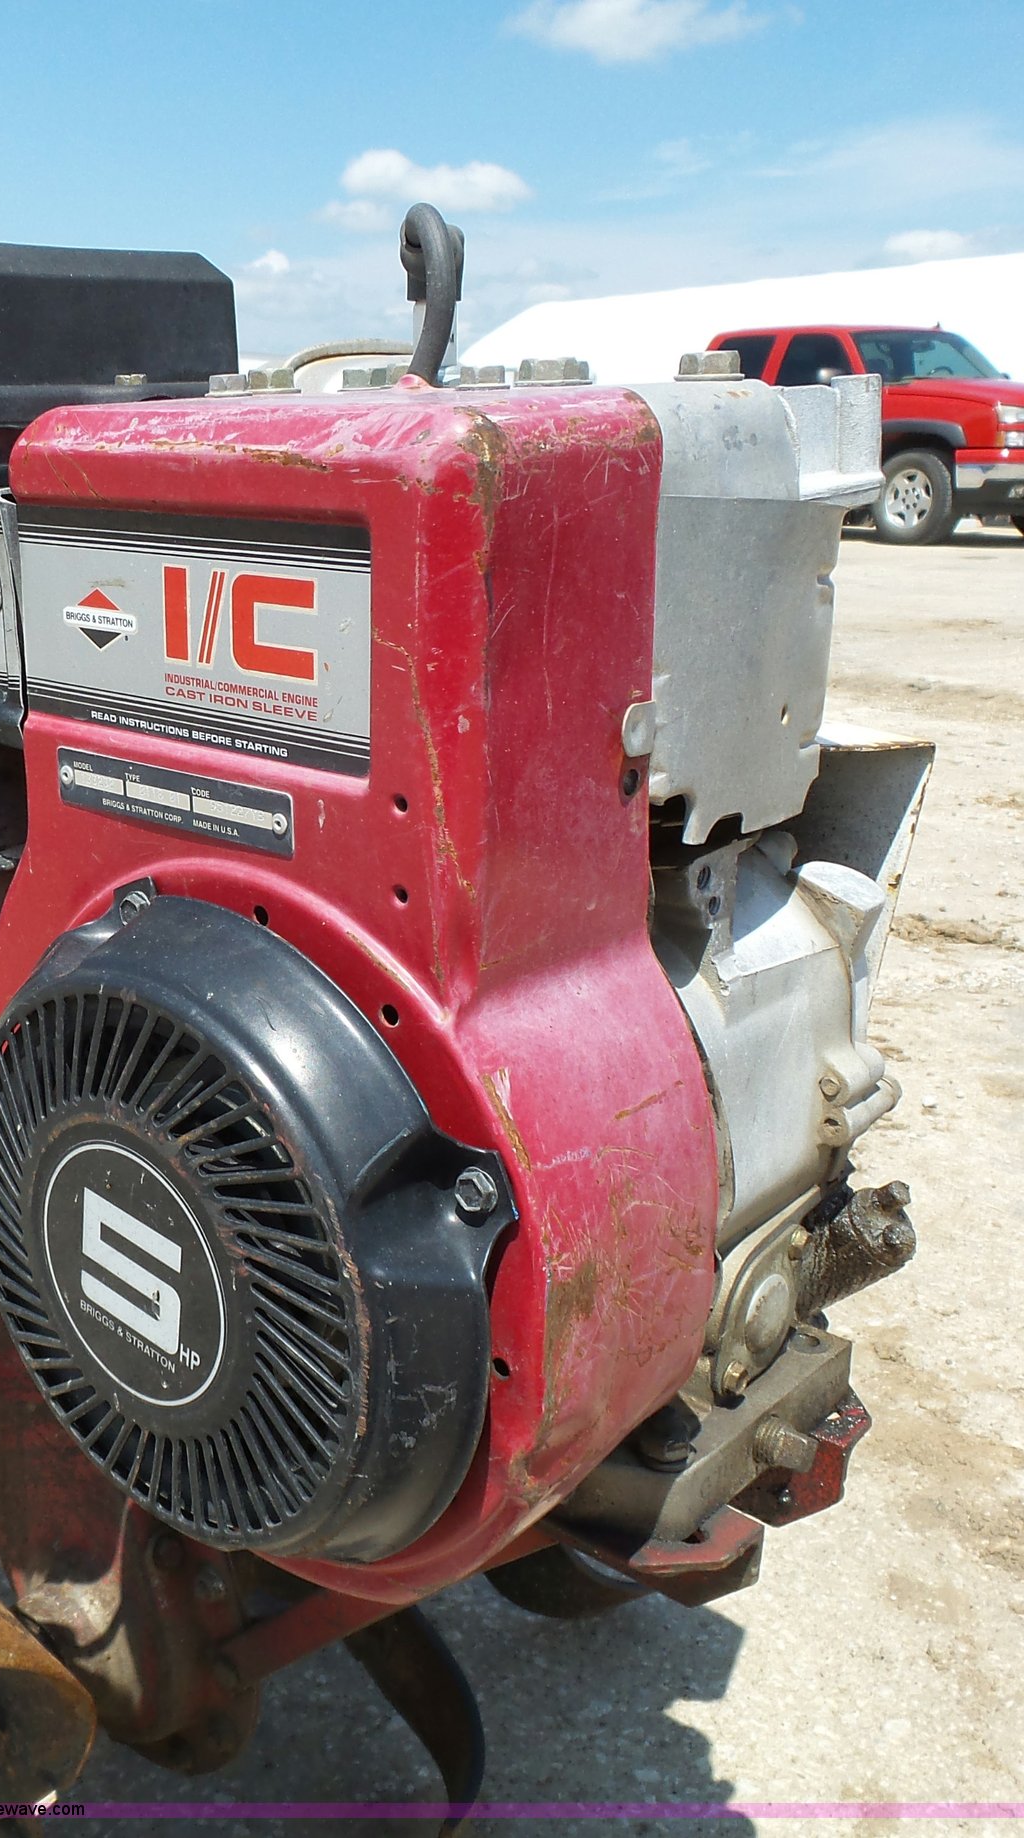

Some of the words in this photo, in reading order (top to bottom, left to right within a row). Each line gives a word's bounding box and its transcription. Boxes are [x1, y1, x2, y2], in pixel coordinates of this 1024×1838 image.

[65, 611, 91, 623] BRIGGS
[97, 615, 134, 628] STRATTON
[164, 673, 279, 701] INDUSTRIAL/COMMERCIAL
[281, 692, 319, 708] ENGINE
[165, 686, 206, 701] CAST
[209, 694, 249, 709] IRON
[252, 701, 318, 722] SLEEVE
[90, 710, 117, 724] READ
[119, 716, 190, 738] INSTRUCTIONS
[191, 730, 233, 746] BEFORE
[234, 739, 288, 757] STARTING
[73, 761, 94, 772] MODEL
[125, 772, 141, 783] TYPE
[191, 787, 211, 798] CODE
[102, 798, 125, 811] BRIGGS
[131, 804, 164, 820] STRATTON
[164, 811, 184, 824] CORP.
[192, 818, 212, 831] MADE
[212, 823, 220, 832] IN
[80, 1186, 183, 1355] 5
[179, 1342, 201, 1371] HP
[80, 1299, 115, 1332] BRIGGS
[116, 1325, 124, 1339] &
[125, 1332, 176, 1374] STRATTON
